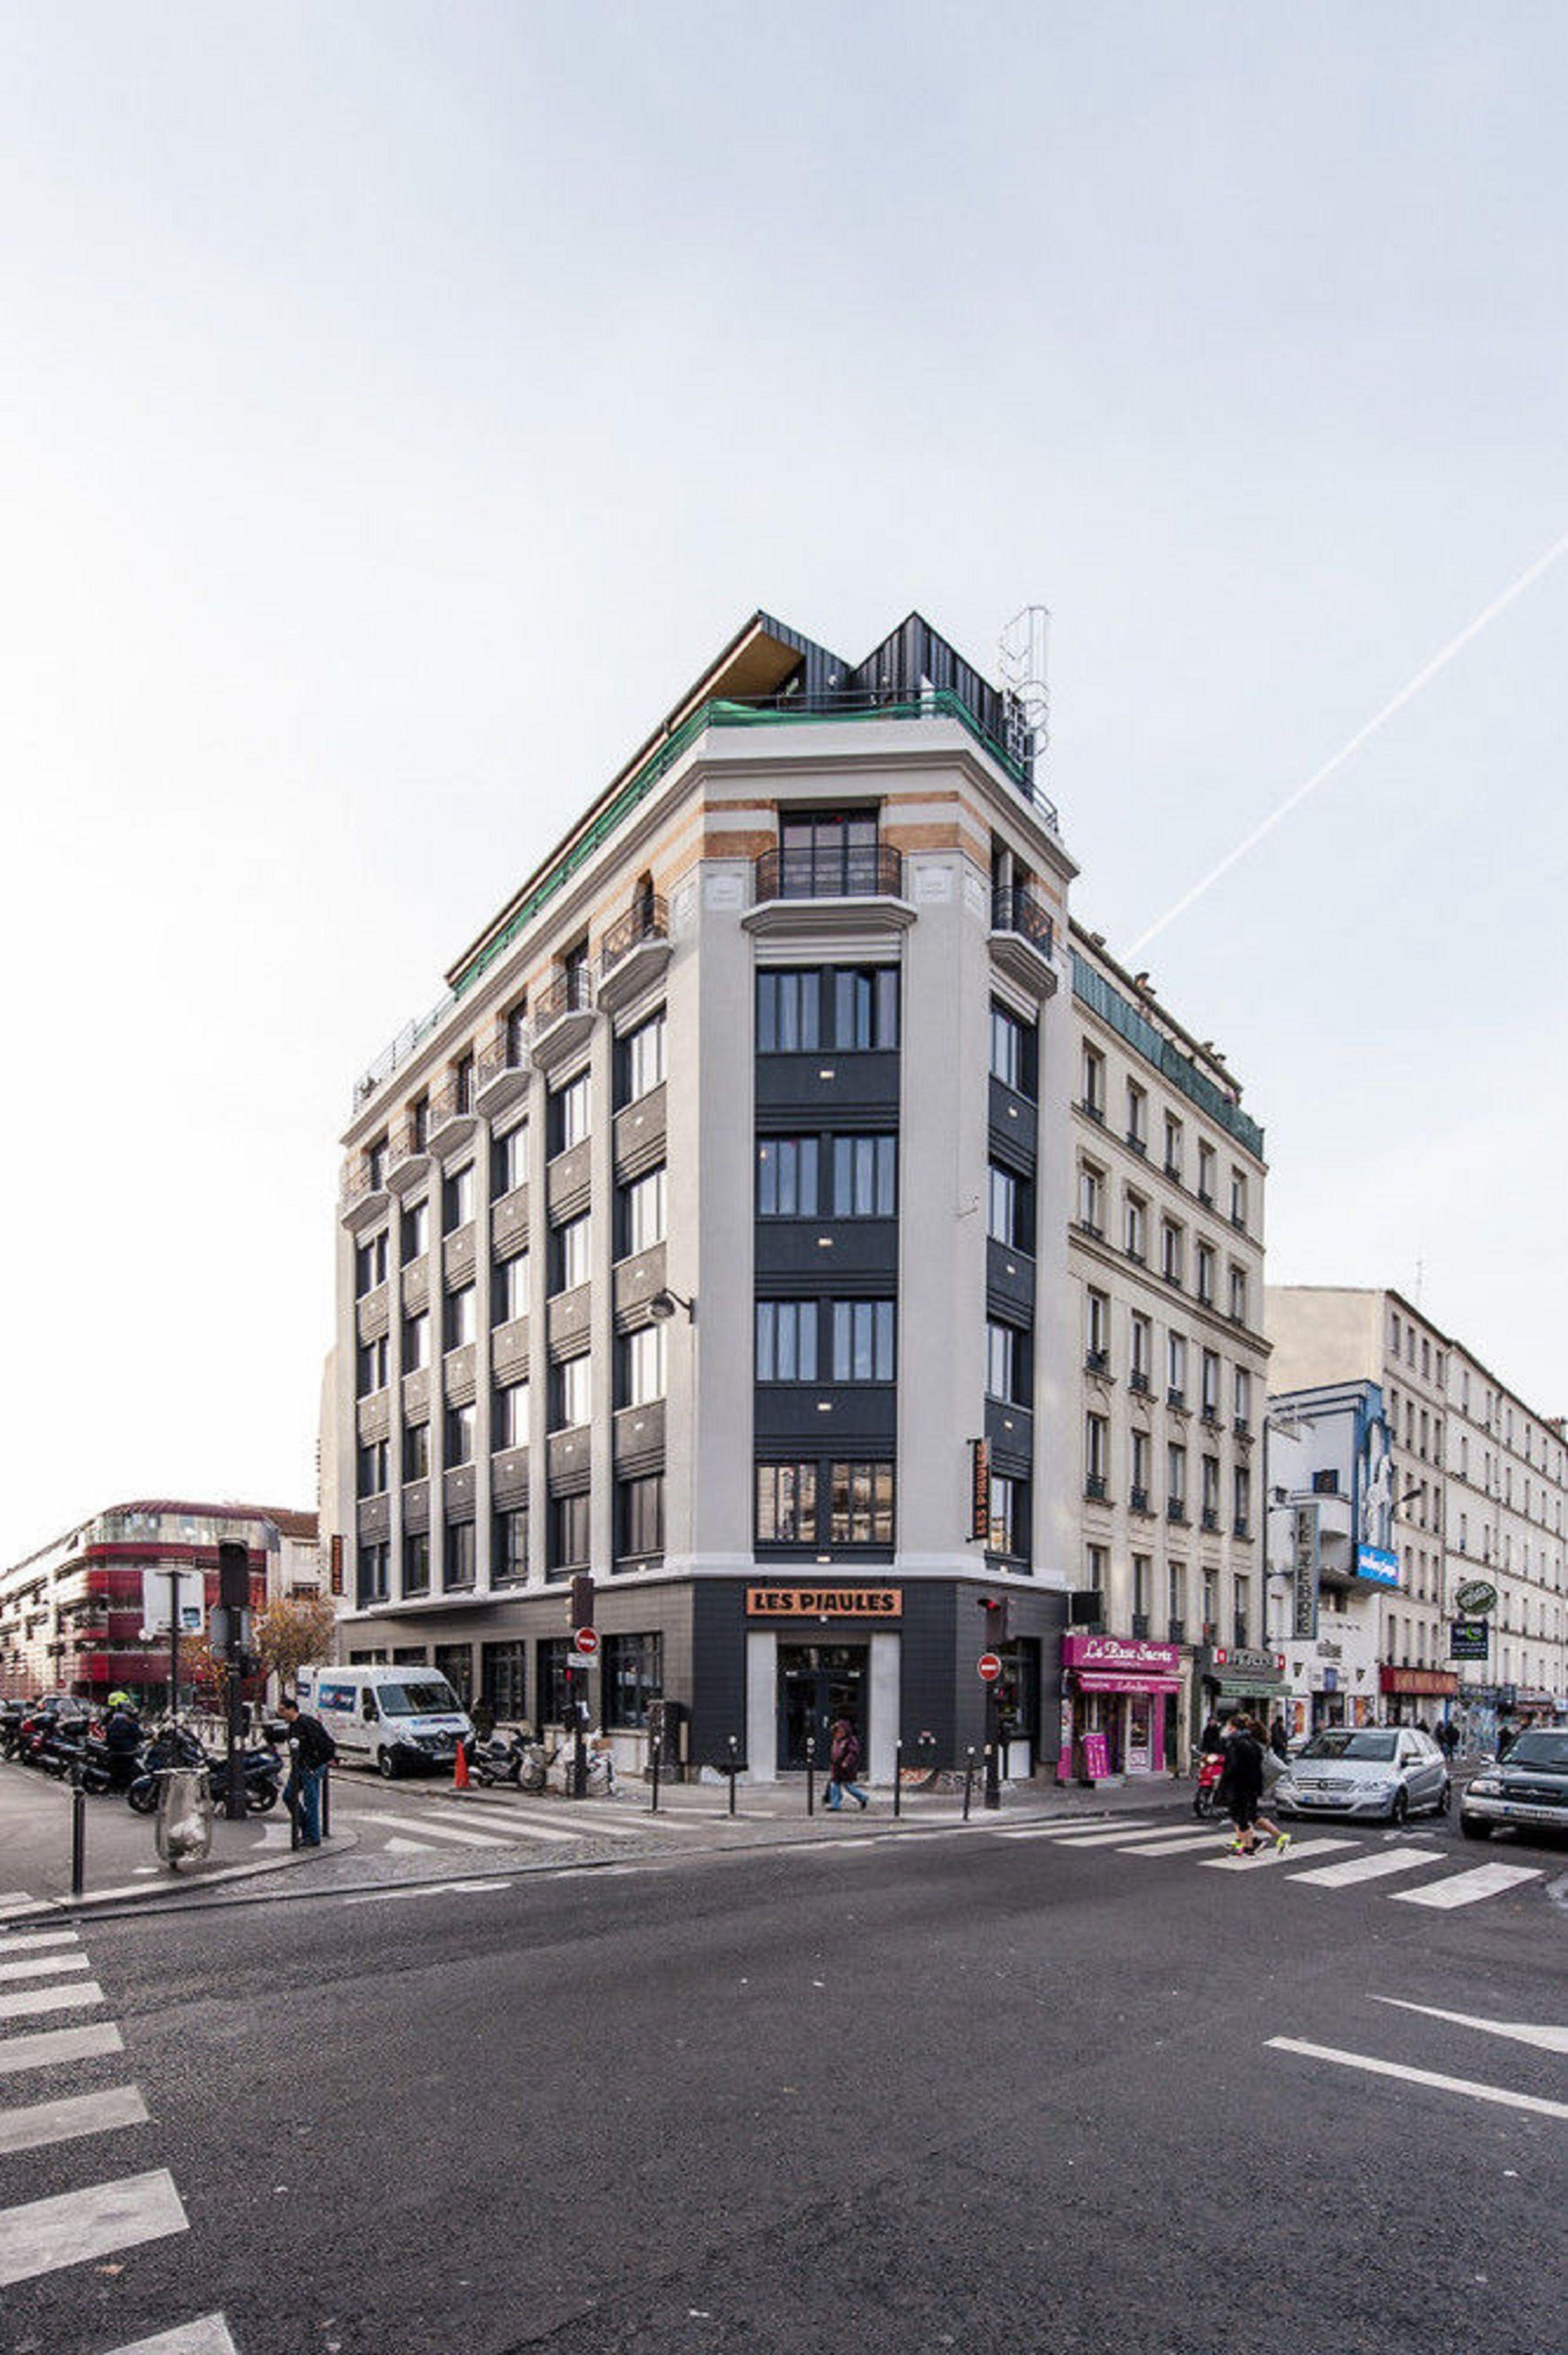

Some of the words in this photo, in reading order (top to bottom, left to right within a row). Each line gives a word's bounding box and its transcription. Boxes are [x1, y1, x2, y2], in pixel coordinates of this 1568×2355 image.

[976, 1442, 988, 1506] PIAULES
[976, 1509, 987, 1535] LES
[755, 1593, 794, 1610] LES
[800, 1593, 895, 1612] PIAULES
